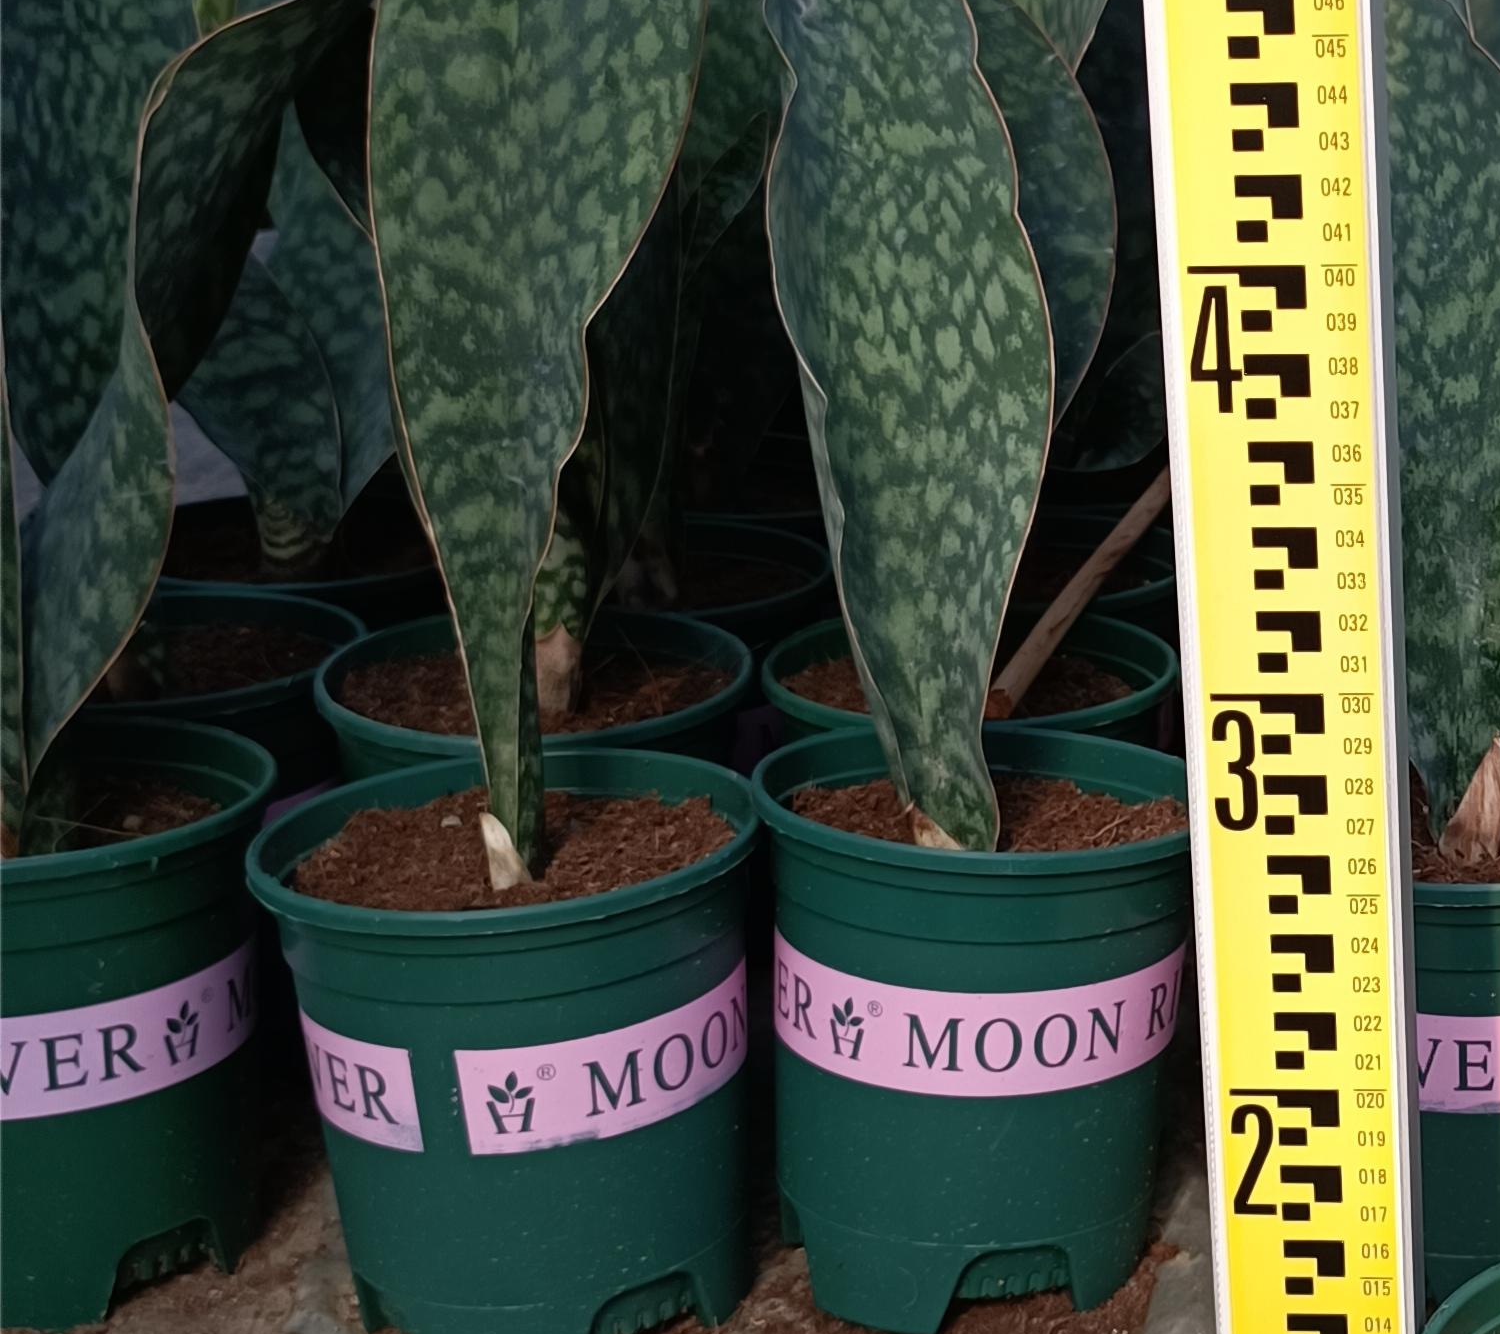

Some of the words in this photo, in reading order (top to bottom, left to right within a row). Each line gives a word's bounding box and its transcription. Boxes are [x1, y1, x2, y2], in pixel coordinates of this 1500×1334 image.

[1315, 38, 1347, 59] 045
[1316, 84, 1348, 105] 044
[1318, 131, 1350, 152] 043
[1320, 176, 1352, 197] 042
[1322, 222, 1351, 242] 041
[1324, 267, 1356, 288] 040
[1326, 312, 1357, 332] 039
[1191, 286, 1242, 413] 4
[1328, 356, 1359, 376] 038
[1329, 400, 1360, 420] 037
[1331, 443, 1362, 463] 036
[1333, 487, 1364, 506] 035
[1335, 529, 1365, 548] 034
[1336, 571, 1367, 590] 033
[1338, 613, 1369, 632] 032
[1340, 655, 1367, 674] 031
[1341, 695, 1371, 715] 030
[1343, 737, 1373, 756] 029
[1213, 710, 1258, 831] 3
[1344, 777, 1374, 796] 028
[1346, 817, 1375, 836] 027
[1347, 857, 1377, 876] 026
[1349, 897, 1379, 915] 025
[1350, 936, 1379, 955] 024
[1352, 975, 1381, 994] 023
[1353, 1014, 1383, 1033] 022
[902, 1000, 1127, 1073] MOON
[1354, 1053, 1381, 1071] 021
[1356, 1092, 1385, 1110] 020
[1357, 1130, 1386, 1148] 019
[1232, 1105, 1276, 1215] 2
[1358, 1167, 1387, 1185] 018
[1359, 1205, 1388, 1223] 017
[1361, 1242, 1390, 1260] 016
[1362, 1279, 1391, 1297] 015
[1364, 1316, 1392, 1334] 014
